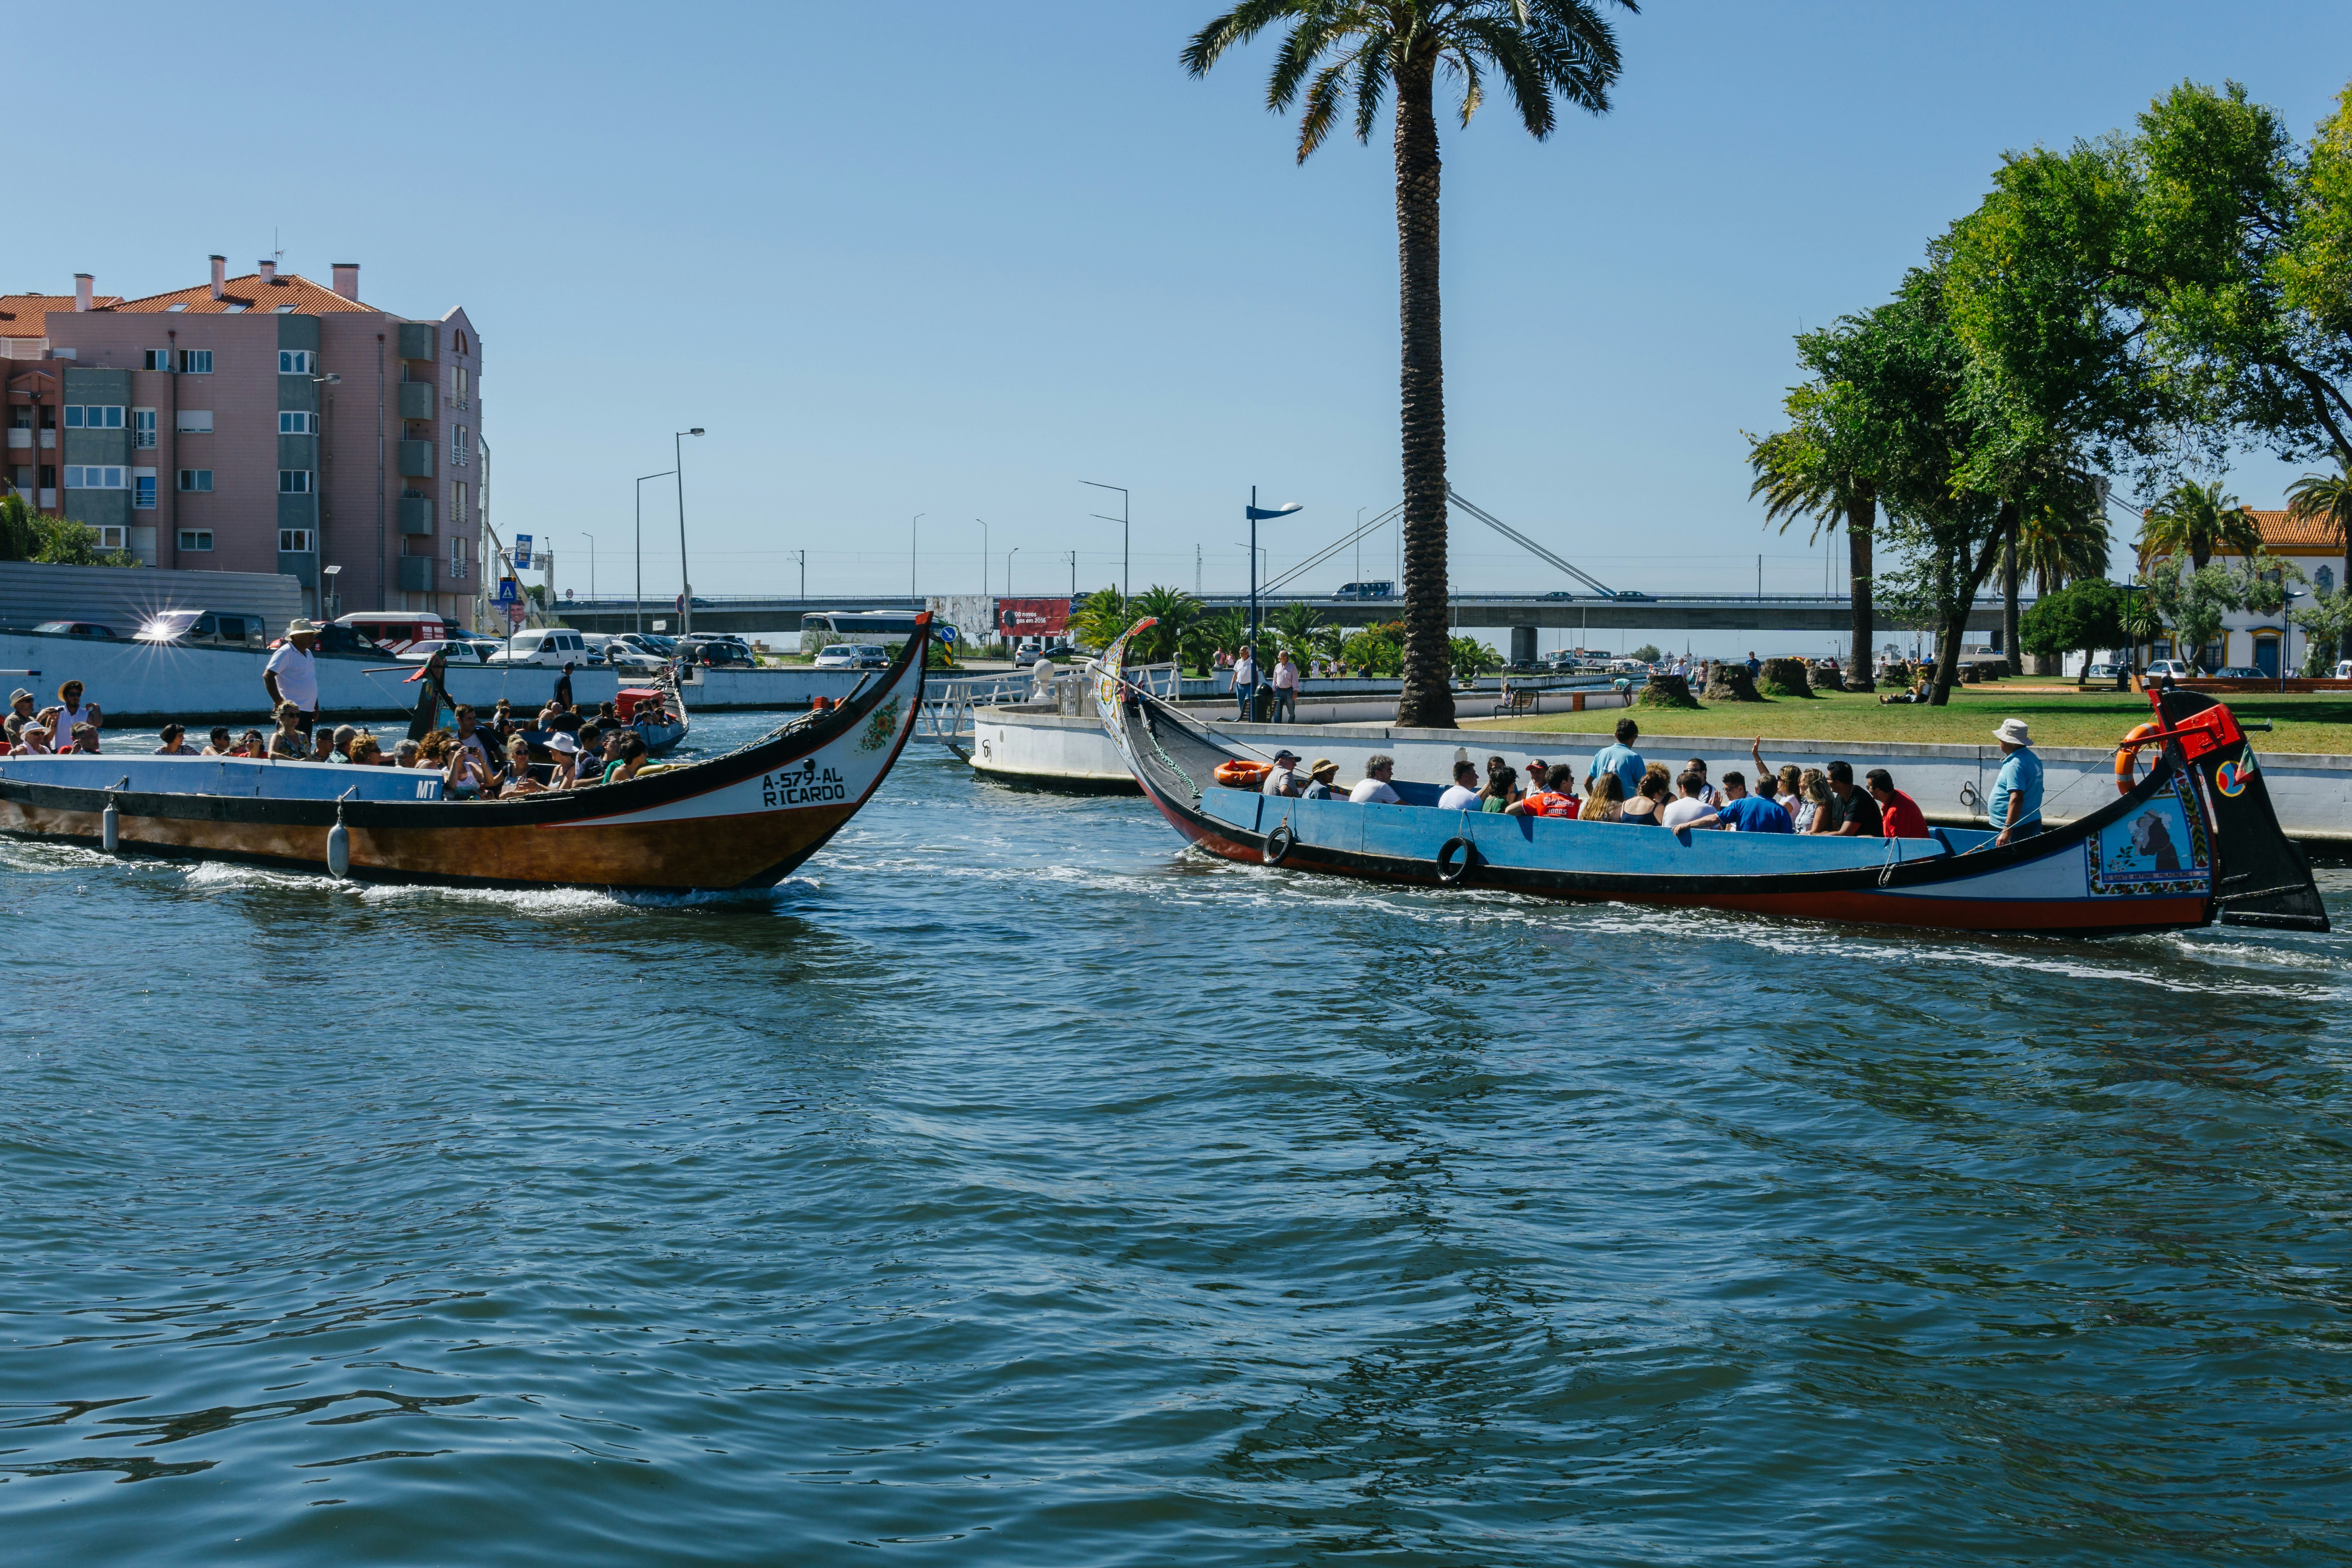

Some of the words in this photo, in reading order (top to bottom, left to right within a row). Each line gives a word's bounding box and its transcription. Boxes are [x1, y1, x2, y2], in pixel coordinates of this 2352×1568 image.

[416, 781, 438, 799] MT
[763, 767, 843, 790] A-579-AL
[763, 784, 845, 807] RICARDO
